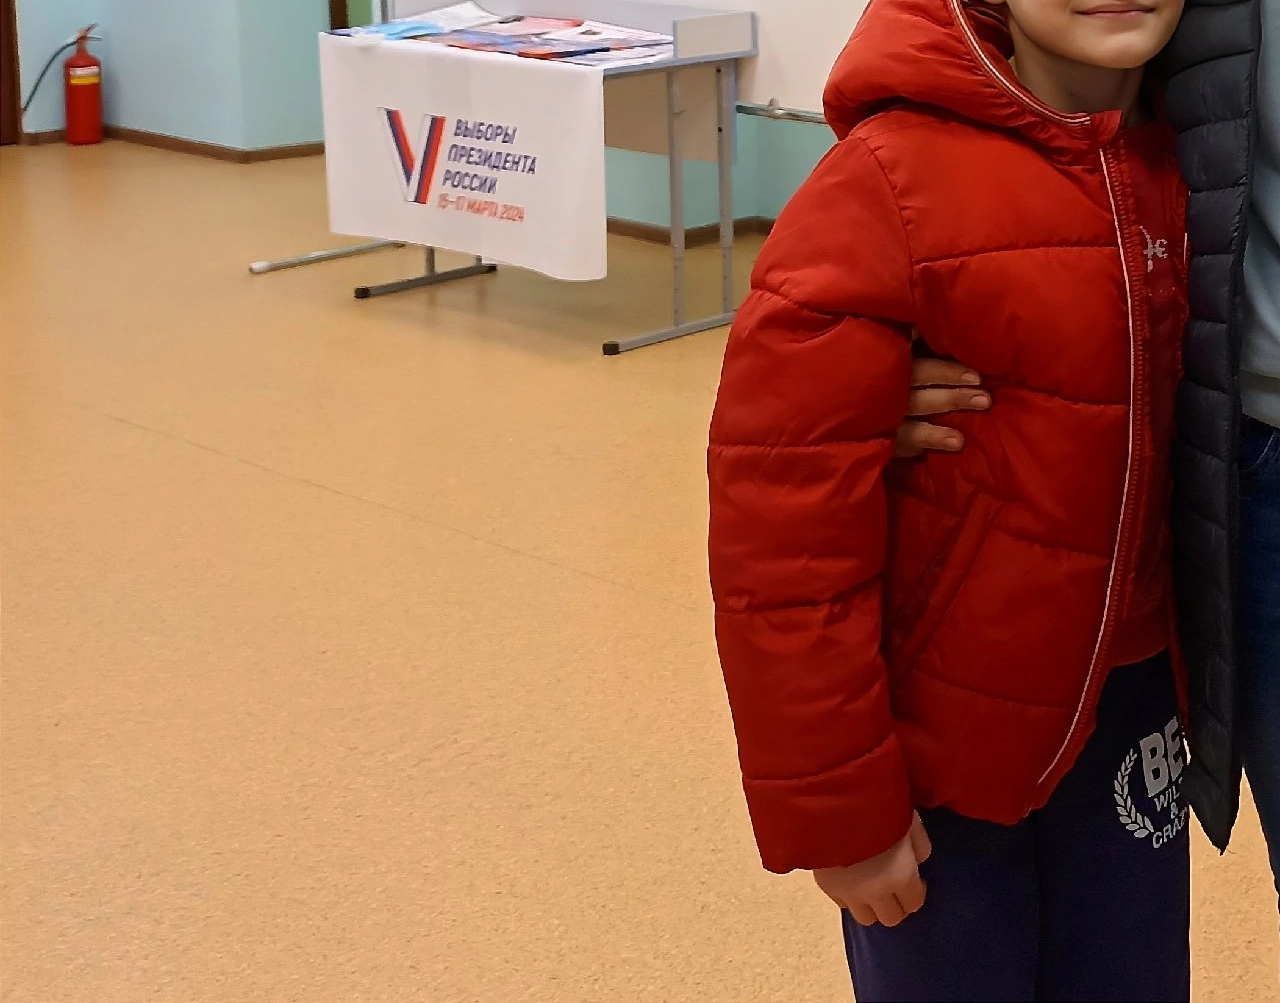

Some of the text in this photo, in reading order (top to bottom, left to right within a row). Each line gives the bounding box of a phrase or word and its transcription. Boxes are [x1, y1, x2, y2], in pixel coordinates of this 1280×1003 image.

[454, 118, 517, 144] ВЫБОРЫ
[447, 144, 537, 174] ПРЕЗИДЕНТА
[442, 169, 498, 194] РОССИИ
[1139, 716, 1184, 798] BE
[1154, 776, 1183, 812] WIL
[1152, 806, 1188, 849] CRAZ
